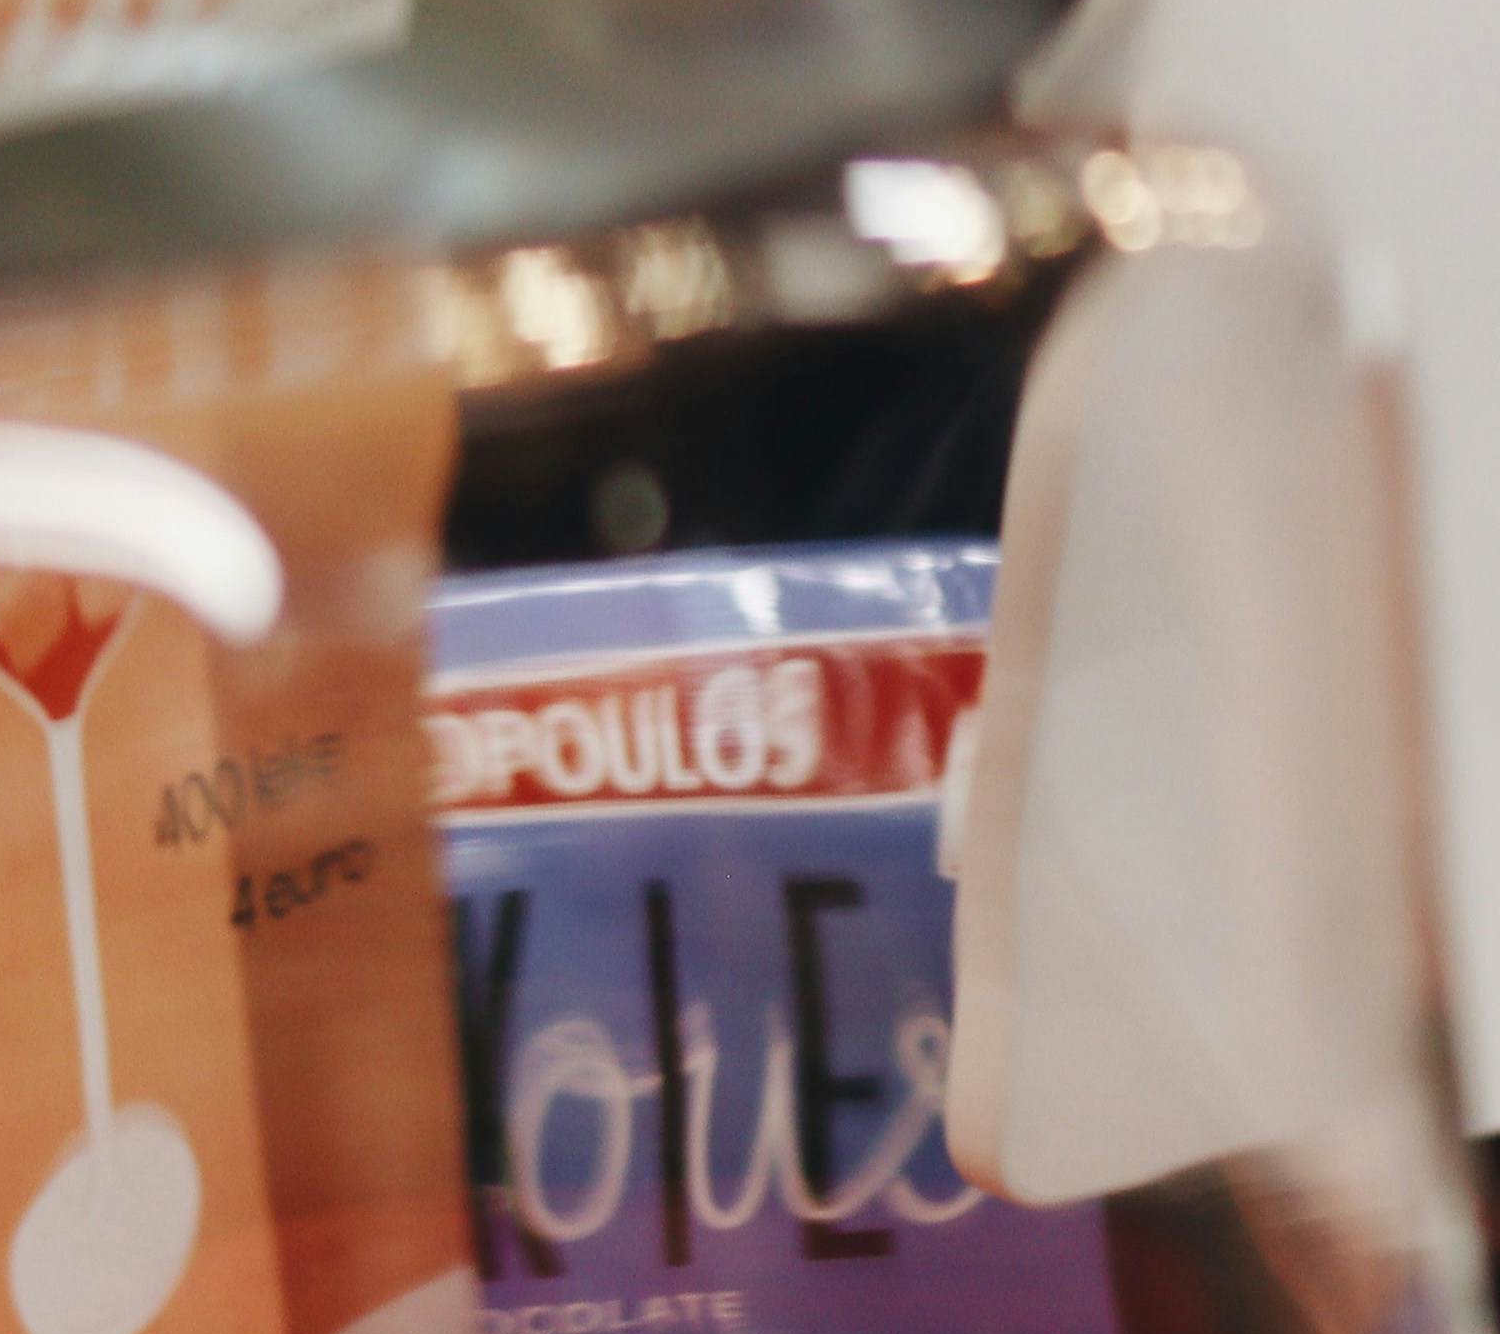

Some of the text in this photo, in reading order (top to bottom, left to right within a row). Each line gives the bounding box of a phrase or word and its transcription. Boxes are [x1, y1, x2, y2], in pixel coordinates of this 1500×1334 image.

[154, 755, 248, 847] 400
[231, 835, 380, 929] 4 euro
